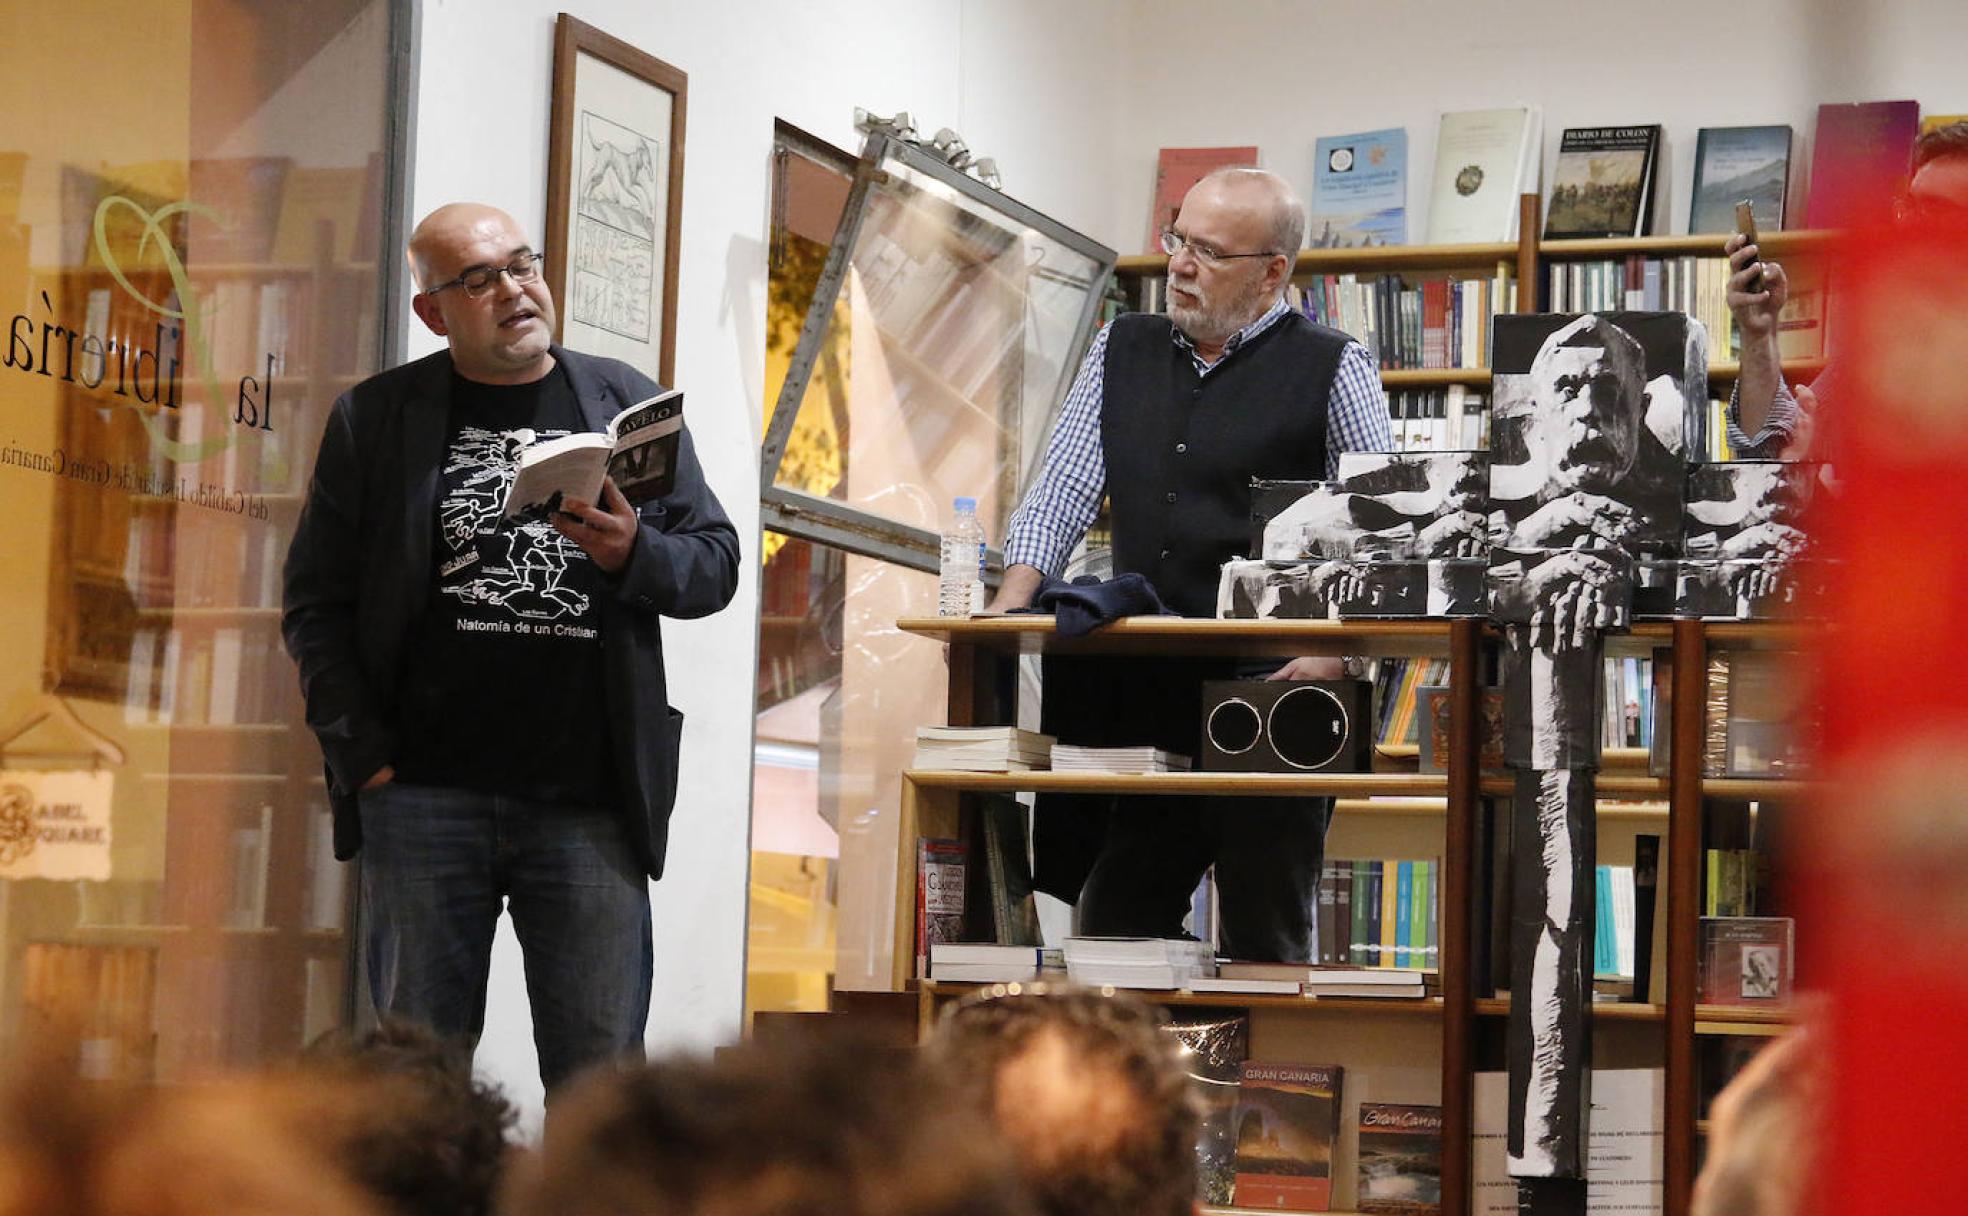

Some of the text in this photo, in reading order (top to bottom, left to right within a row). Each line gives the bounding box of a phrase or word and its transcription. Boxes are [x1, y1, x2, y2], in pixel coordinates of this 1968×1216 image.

[514, 621, 531, 634] de
[534, 625, 551, 635] un
[1245, 1069, 1329, 1082] GRAN CANARIA
